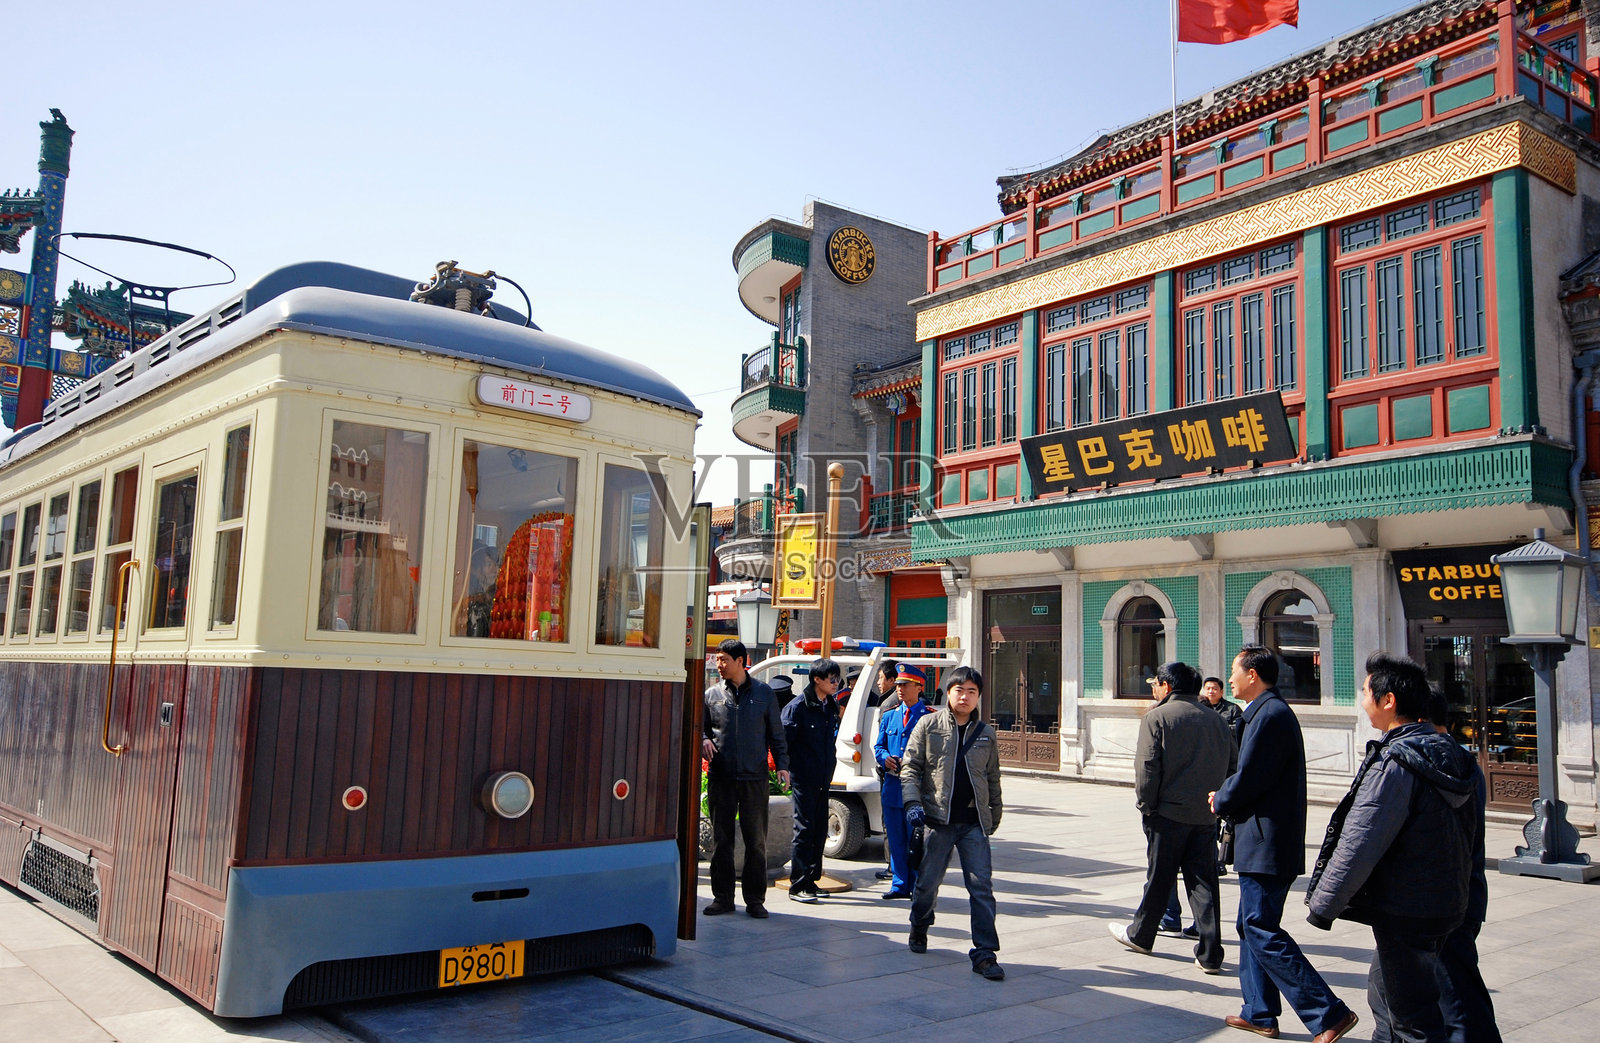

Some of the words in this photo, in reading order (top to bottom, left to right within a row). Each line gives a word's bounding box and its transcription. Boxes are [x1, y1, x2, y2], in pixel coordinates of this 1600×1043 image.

[832, 228, 875, 259] STARBUCKS
[835, 260, 869, 280] COFFEE
[501, 384, 571, 413] 前门二号
[1040, 408, 1269, 482] 星巴克咖啡
[444, 950, 515, 983] D9801
